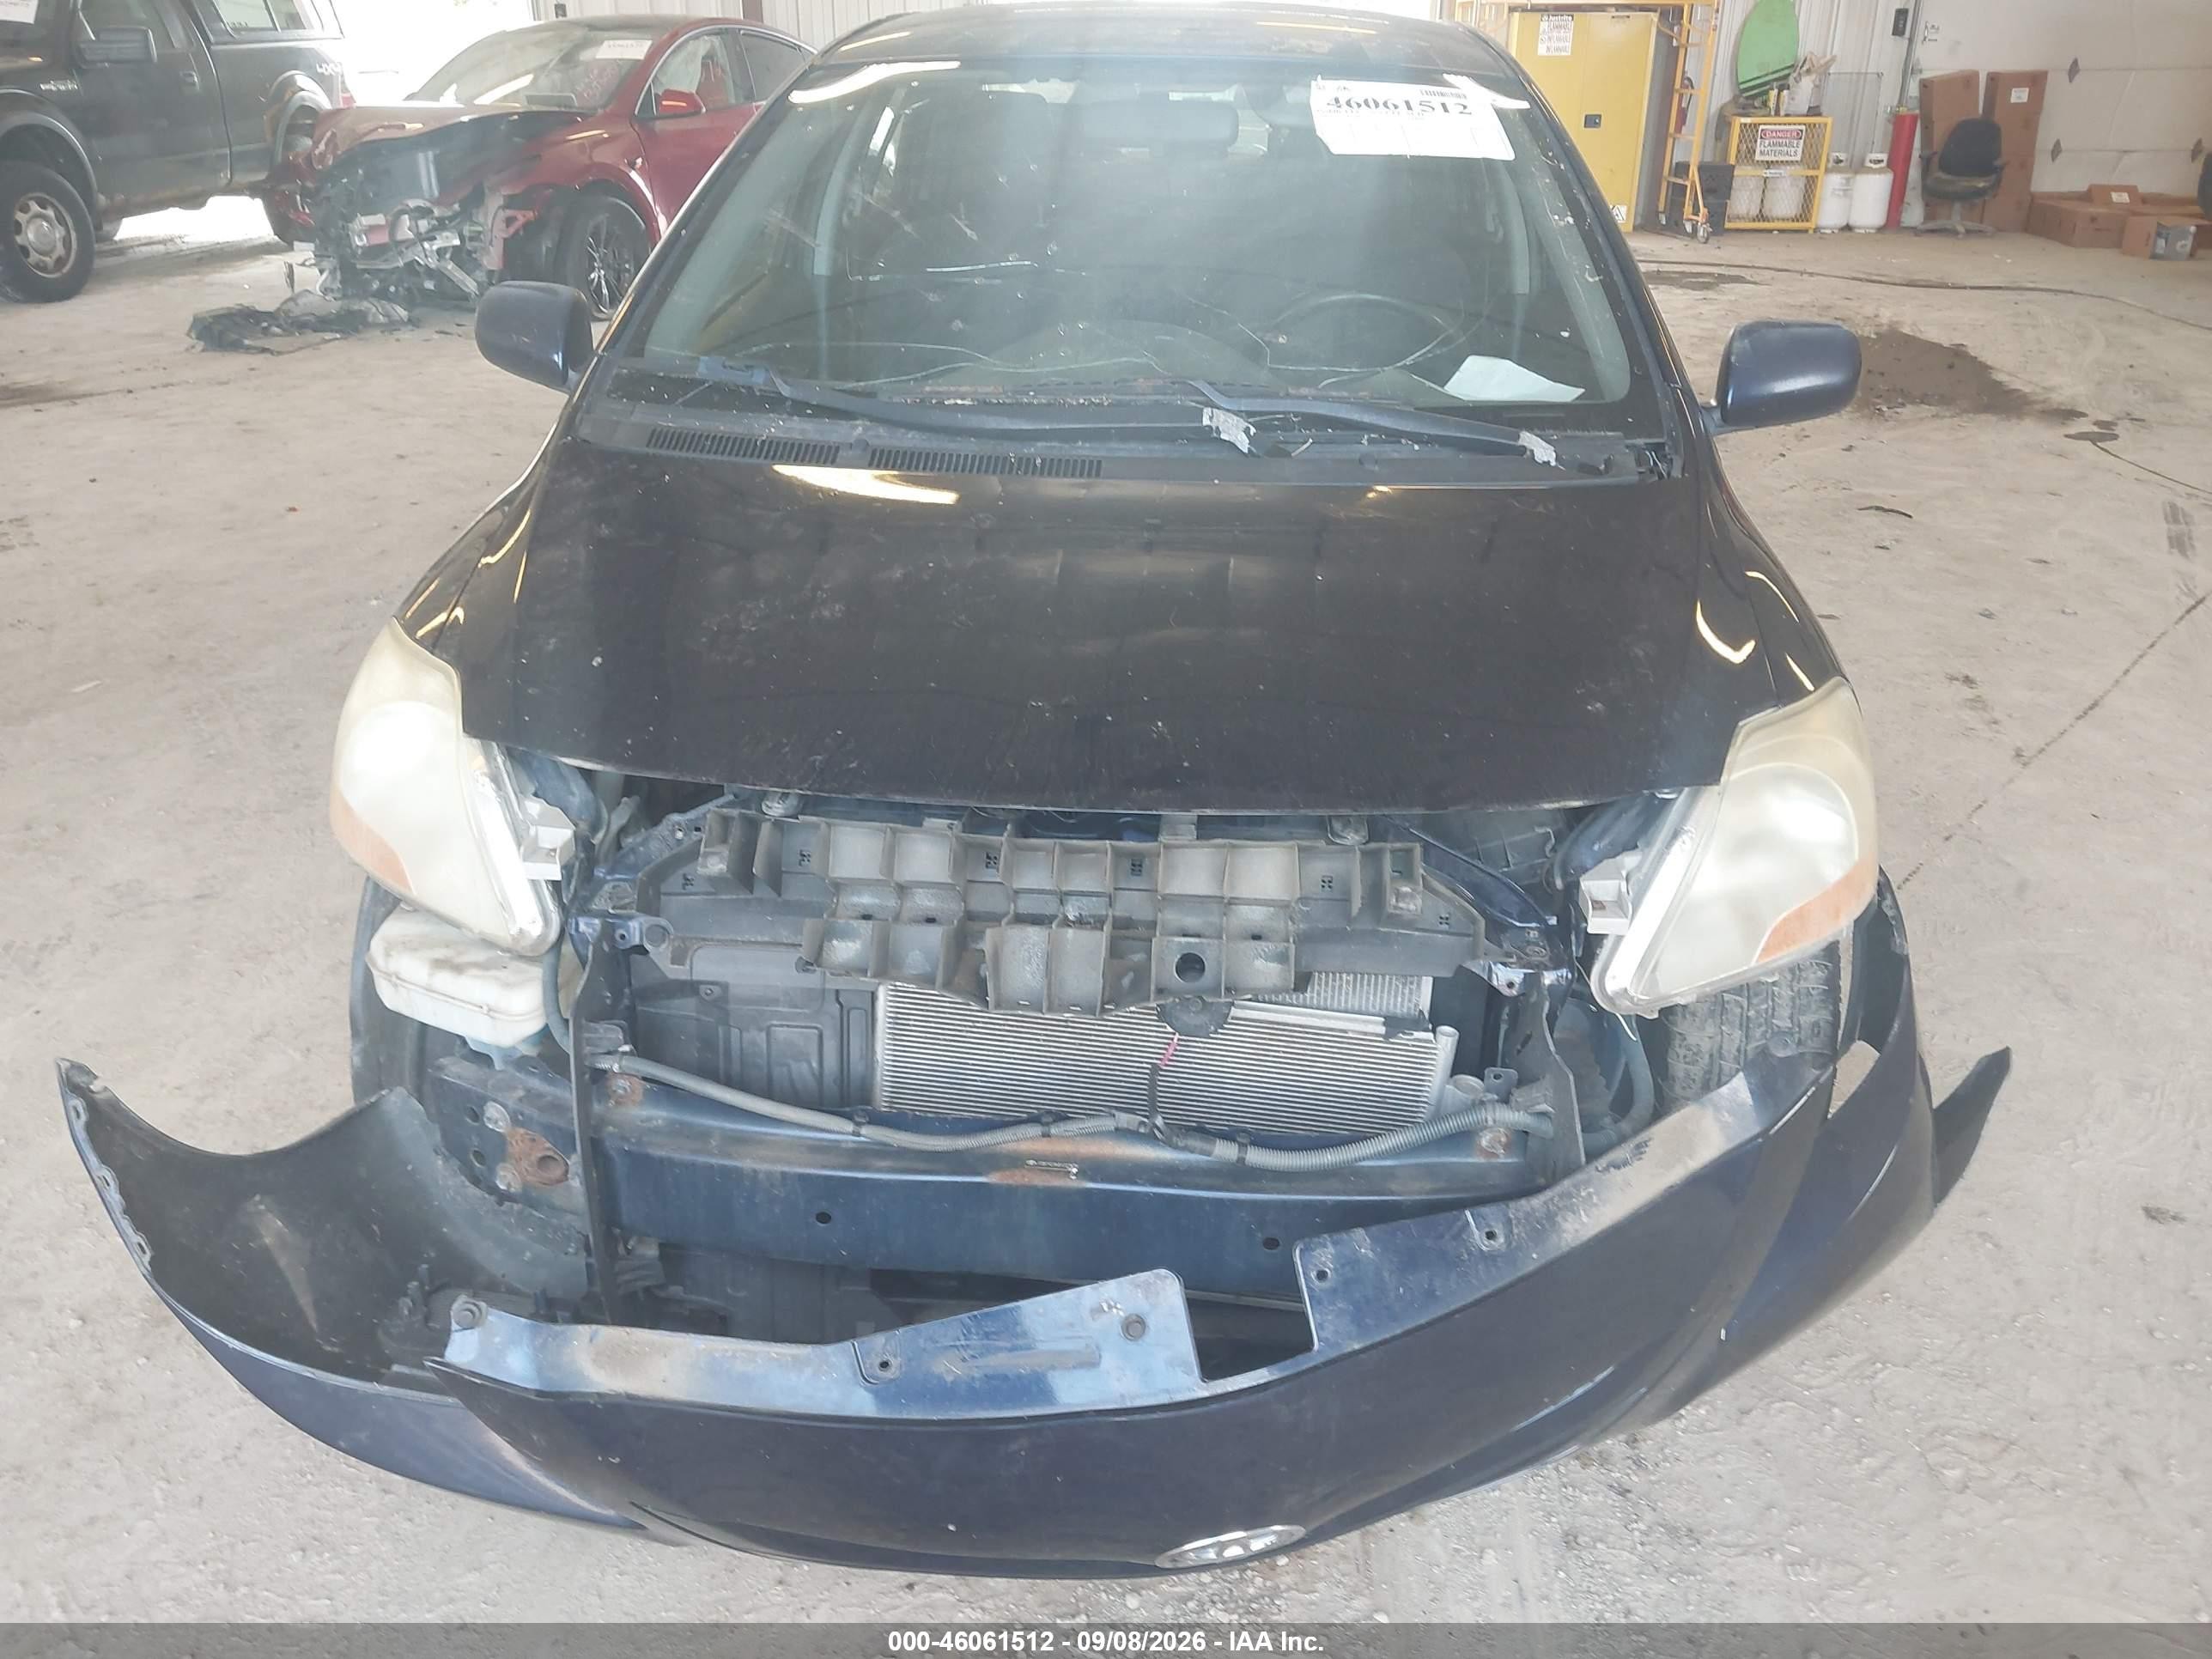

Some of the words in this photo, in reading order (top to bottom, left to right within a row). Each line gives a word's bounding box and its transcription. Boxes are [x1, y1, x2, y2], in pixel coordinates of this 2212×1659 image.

[1327, 96, 1472, 115] 46061512
[1759, 140, 1801, 149] FLAMMABLE
[1759, 149, 1799, 157] MATERIALS
